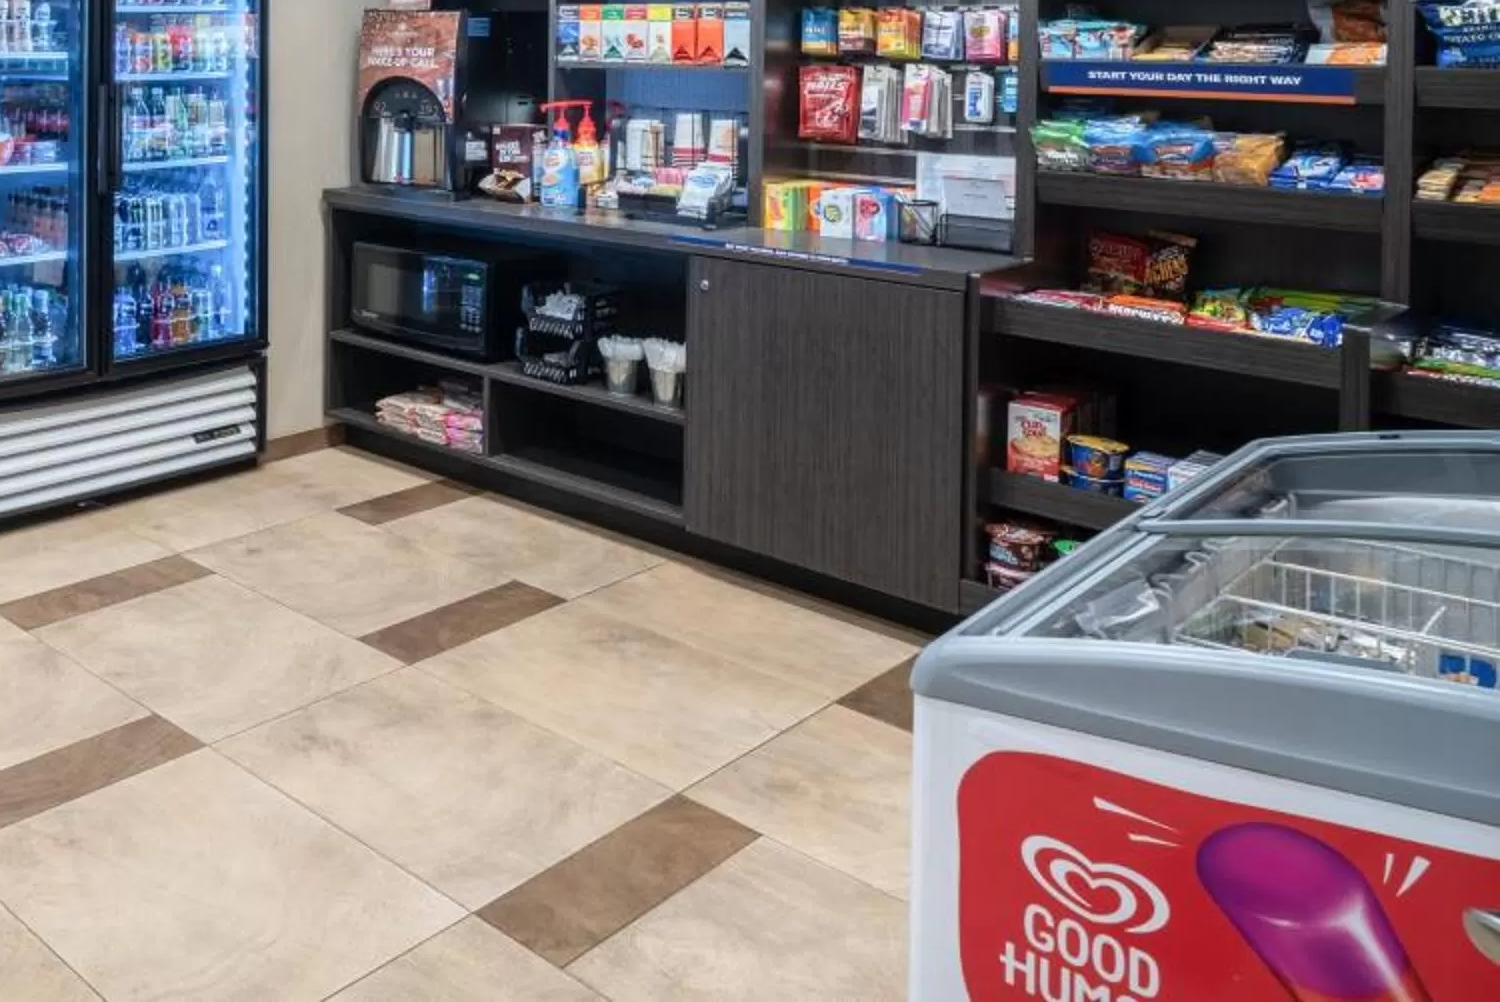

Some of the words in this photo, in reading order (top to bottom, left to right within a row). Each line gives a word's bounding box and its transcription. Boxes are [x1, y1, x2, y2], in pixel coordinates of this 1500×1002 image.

[1087, 70, 1127, 80] START
[1129, 71, 1164, 82] YOUR
[1167, 72, 1193, 82] DAY
[1195, 73, 1222, 83] THE
[1224, 74, 1267, 85] RIGHT
[1269, 76, 1302, 86] WAY
[999, 941, 1141, 1002] HUM
[1023, 903, 1160, 999] GOOD
